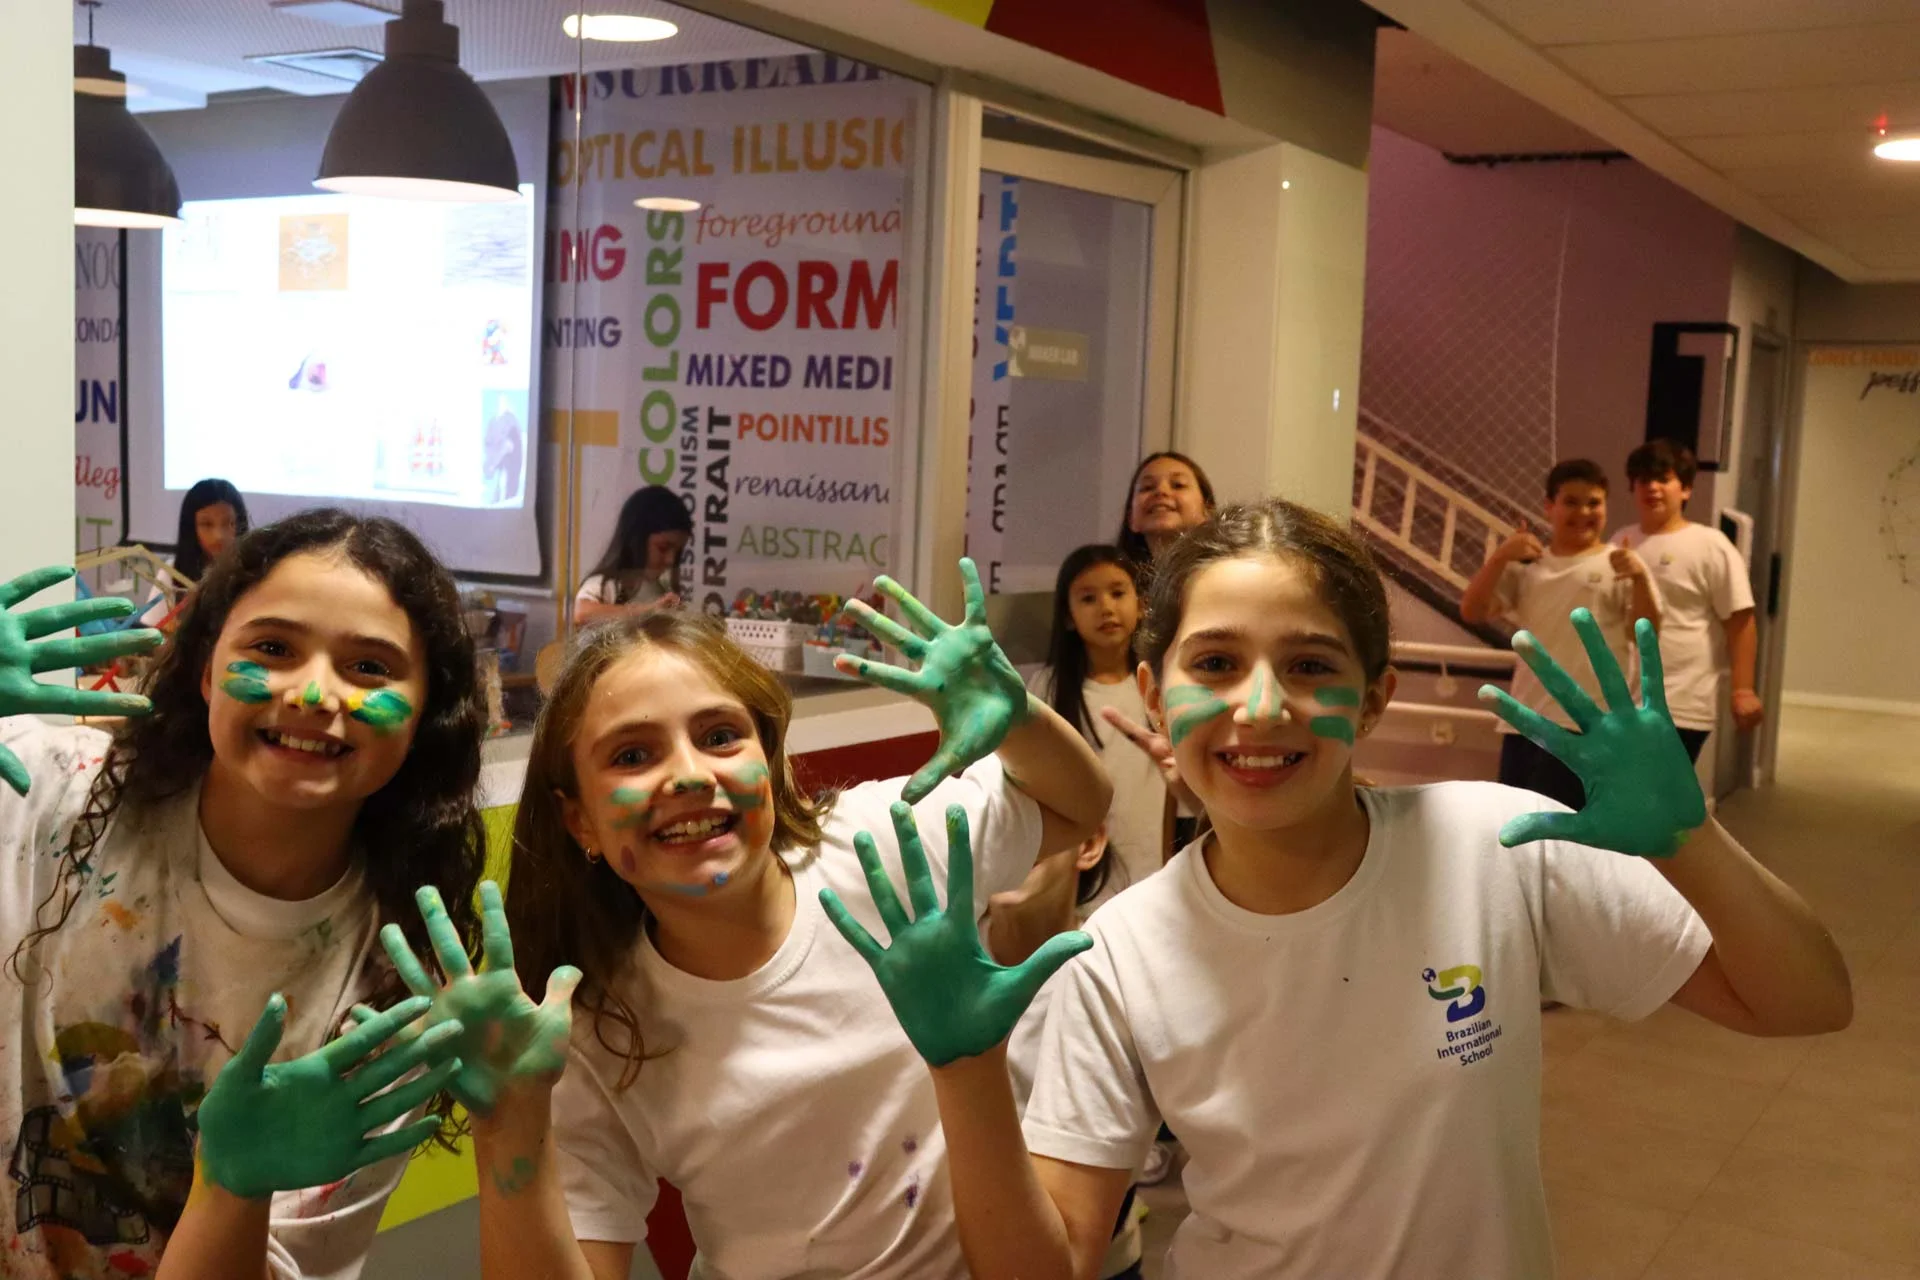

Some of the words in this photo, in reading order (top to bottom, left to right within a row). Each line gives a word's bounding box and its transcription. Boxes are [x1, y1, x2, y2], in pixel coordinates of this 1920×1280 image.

[556, 129, 714, 189] OPTICAL
[696, 260, 898, 331] FORM
[638, 211, 684, 486] COLORS
[686, 353, 791, 388] MIXED
[803, 354, 892, 390] MEDI
[737, 413, 889, 446] POINTILIS
[736, 525, 888, 566] ABSTRAC
[1437, 1024, 1502, 1059] International
[1446, 1019, 1492, 1042] Brazilian
[1460, 1044, 1493, 1066] School
